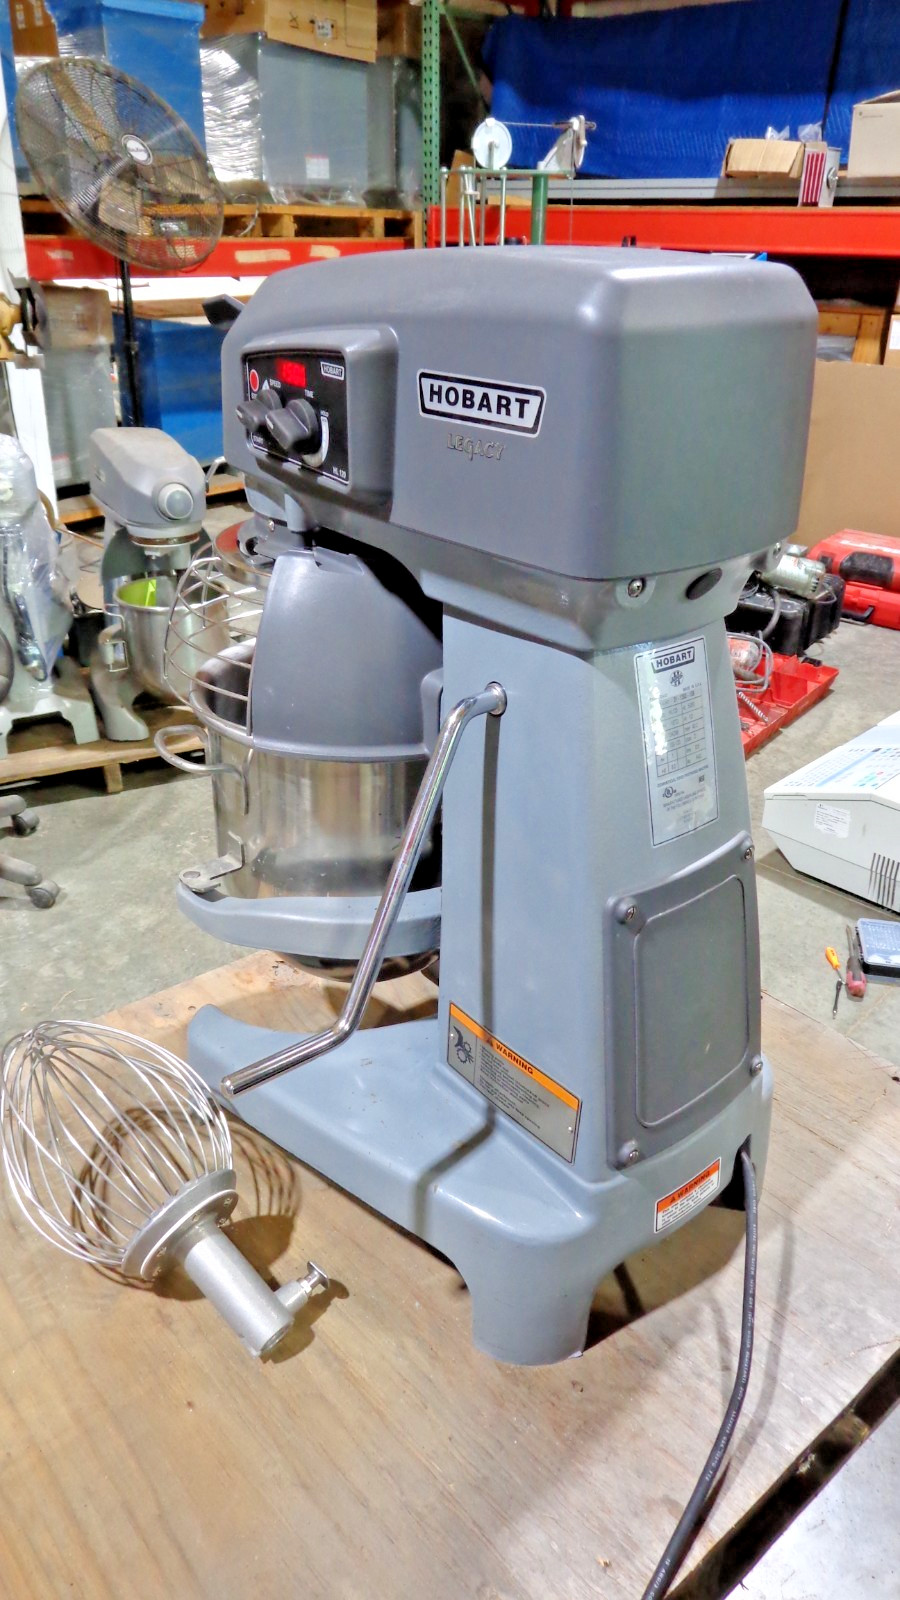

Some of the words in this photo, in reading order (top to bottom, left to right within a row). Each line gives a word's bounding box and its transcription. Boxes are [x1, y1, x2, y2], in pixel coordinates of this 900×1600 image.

[323, 364, 342, 377] HOBART
[269, 378, 281, 389] SPEED
[304, 389, 314, 399] TIME
[429, 383, 530, 419] HOBART
[447, 433, 505, 461] LEGACY
[656, 650, 692, 668] HOBART
[496, 1042, 534, 1075] WARNING
[677, 1170, 710, 1198] WARNING
